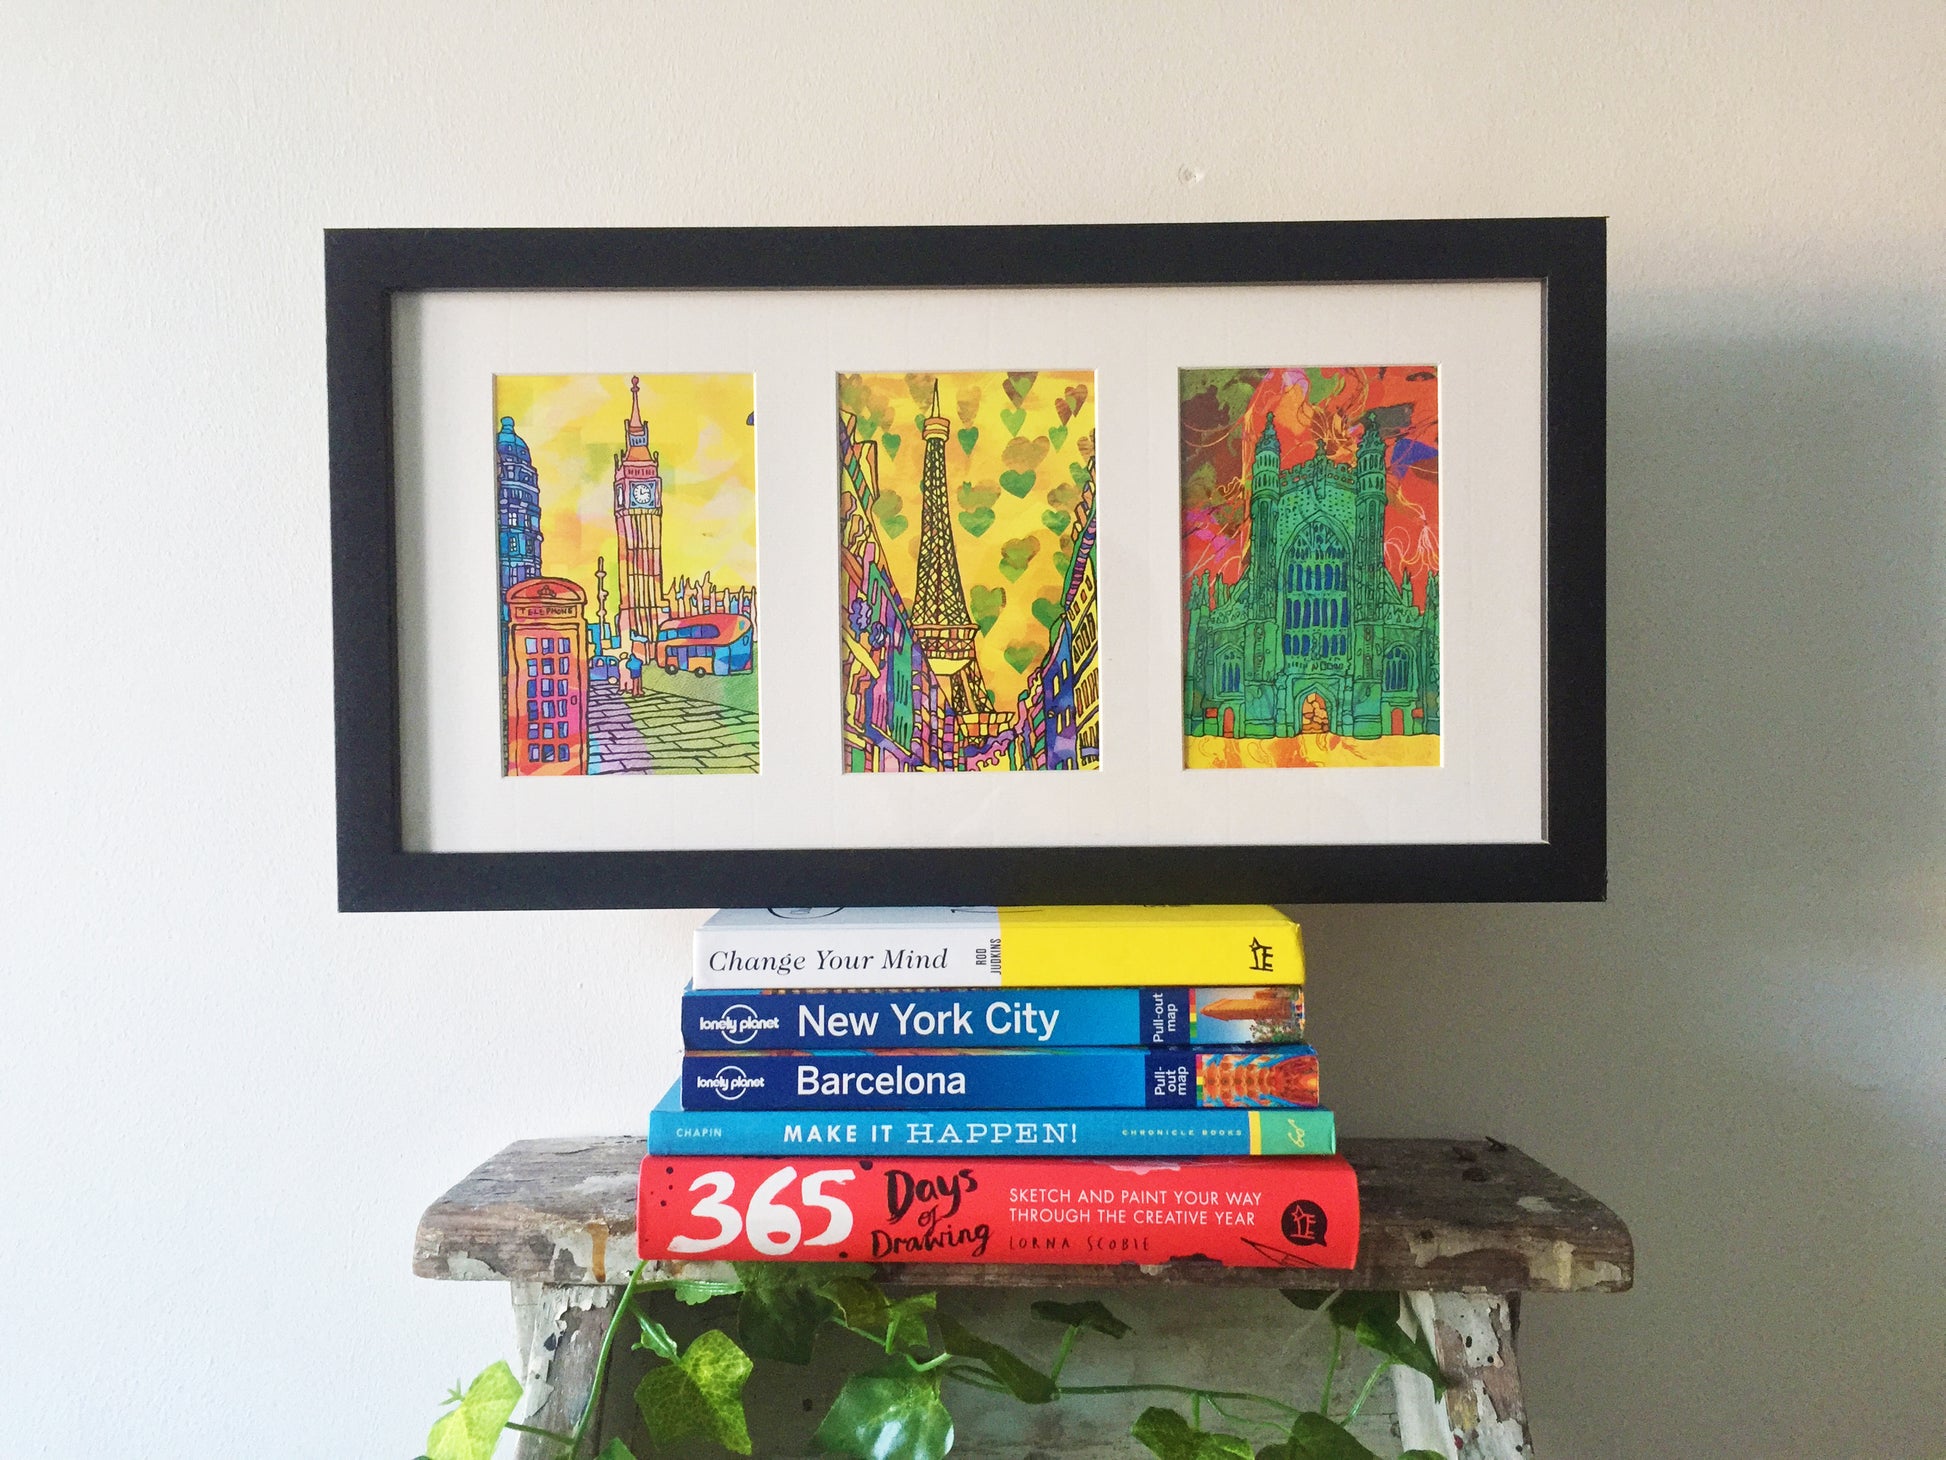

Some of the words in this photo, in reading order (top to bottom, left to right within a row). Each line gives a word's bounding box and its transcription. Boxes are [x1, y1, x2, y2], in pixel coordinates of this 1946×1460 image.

[709, 949, 805, 976] Change
[816, 949, 874, 971] Your
[881, 947, 948, 970] Mind
[975, 948, 988, 966] ROD
[990, 937, 1002, 975] JUDKINS
[699, 1016, 739, 1033] lonely
[739, 1015, 779, 1032] planet
[798, 1004, 879, 1037] New
[890, 1003, 974, 1036] York
[985, 1001, 1060, 1042] City
[1152, 992, 1164, 1043] Pull-out
[1166, 1003, 1179, 1032] map
[697, 1076, 730, 1090] lonely
[730, 1075, 765, 1090] planet
[797, 1064, 966, 1096] Barcelona
[1154, 1066, 1166, 1096] Pull-
[1167, 1069, 1177, 1093] out
[1176, 1066, 1189, 1096] map
[676, 1127, 722, 1138] CHAPIN
[783, 1124, 857, 1143] MAKE
[871, 1124, 893, 1143] IT
[906, 1122, 1077, 1144] HAPPEN!
[668, 1165, 857, 1256] 365
[884, 1168, 978, 1225] Days
[1009, 1188, 1071, 1203] SKETCH
[1077, 1189, 1115, 1204] AND
[1121, 1190, 1167, 1205] PAINT
[1173, 1190, 1219, 1205] YOUR
[1225, 1191, 1262, 1206] WAY
[917, 1205, 939, 1236] of
[1009, 1208, 1091, 1223] THROUGH
[1097, 1209, 1126, 1224] THE
[1133, 1210, 1206, 1225] CREATIVE
[1215, 1211, 1255, 1226] YEAR
[870, 1223, 990, 1258] Drawing
[1009, 1236, 1070, 1250] LORNA
[1087, 1236, 1150, 1251] SCOBIE
